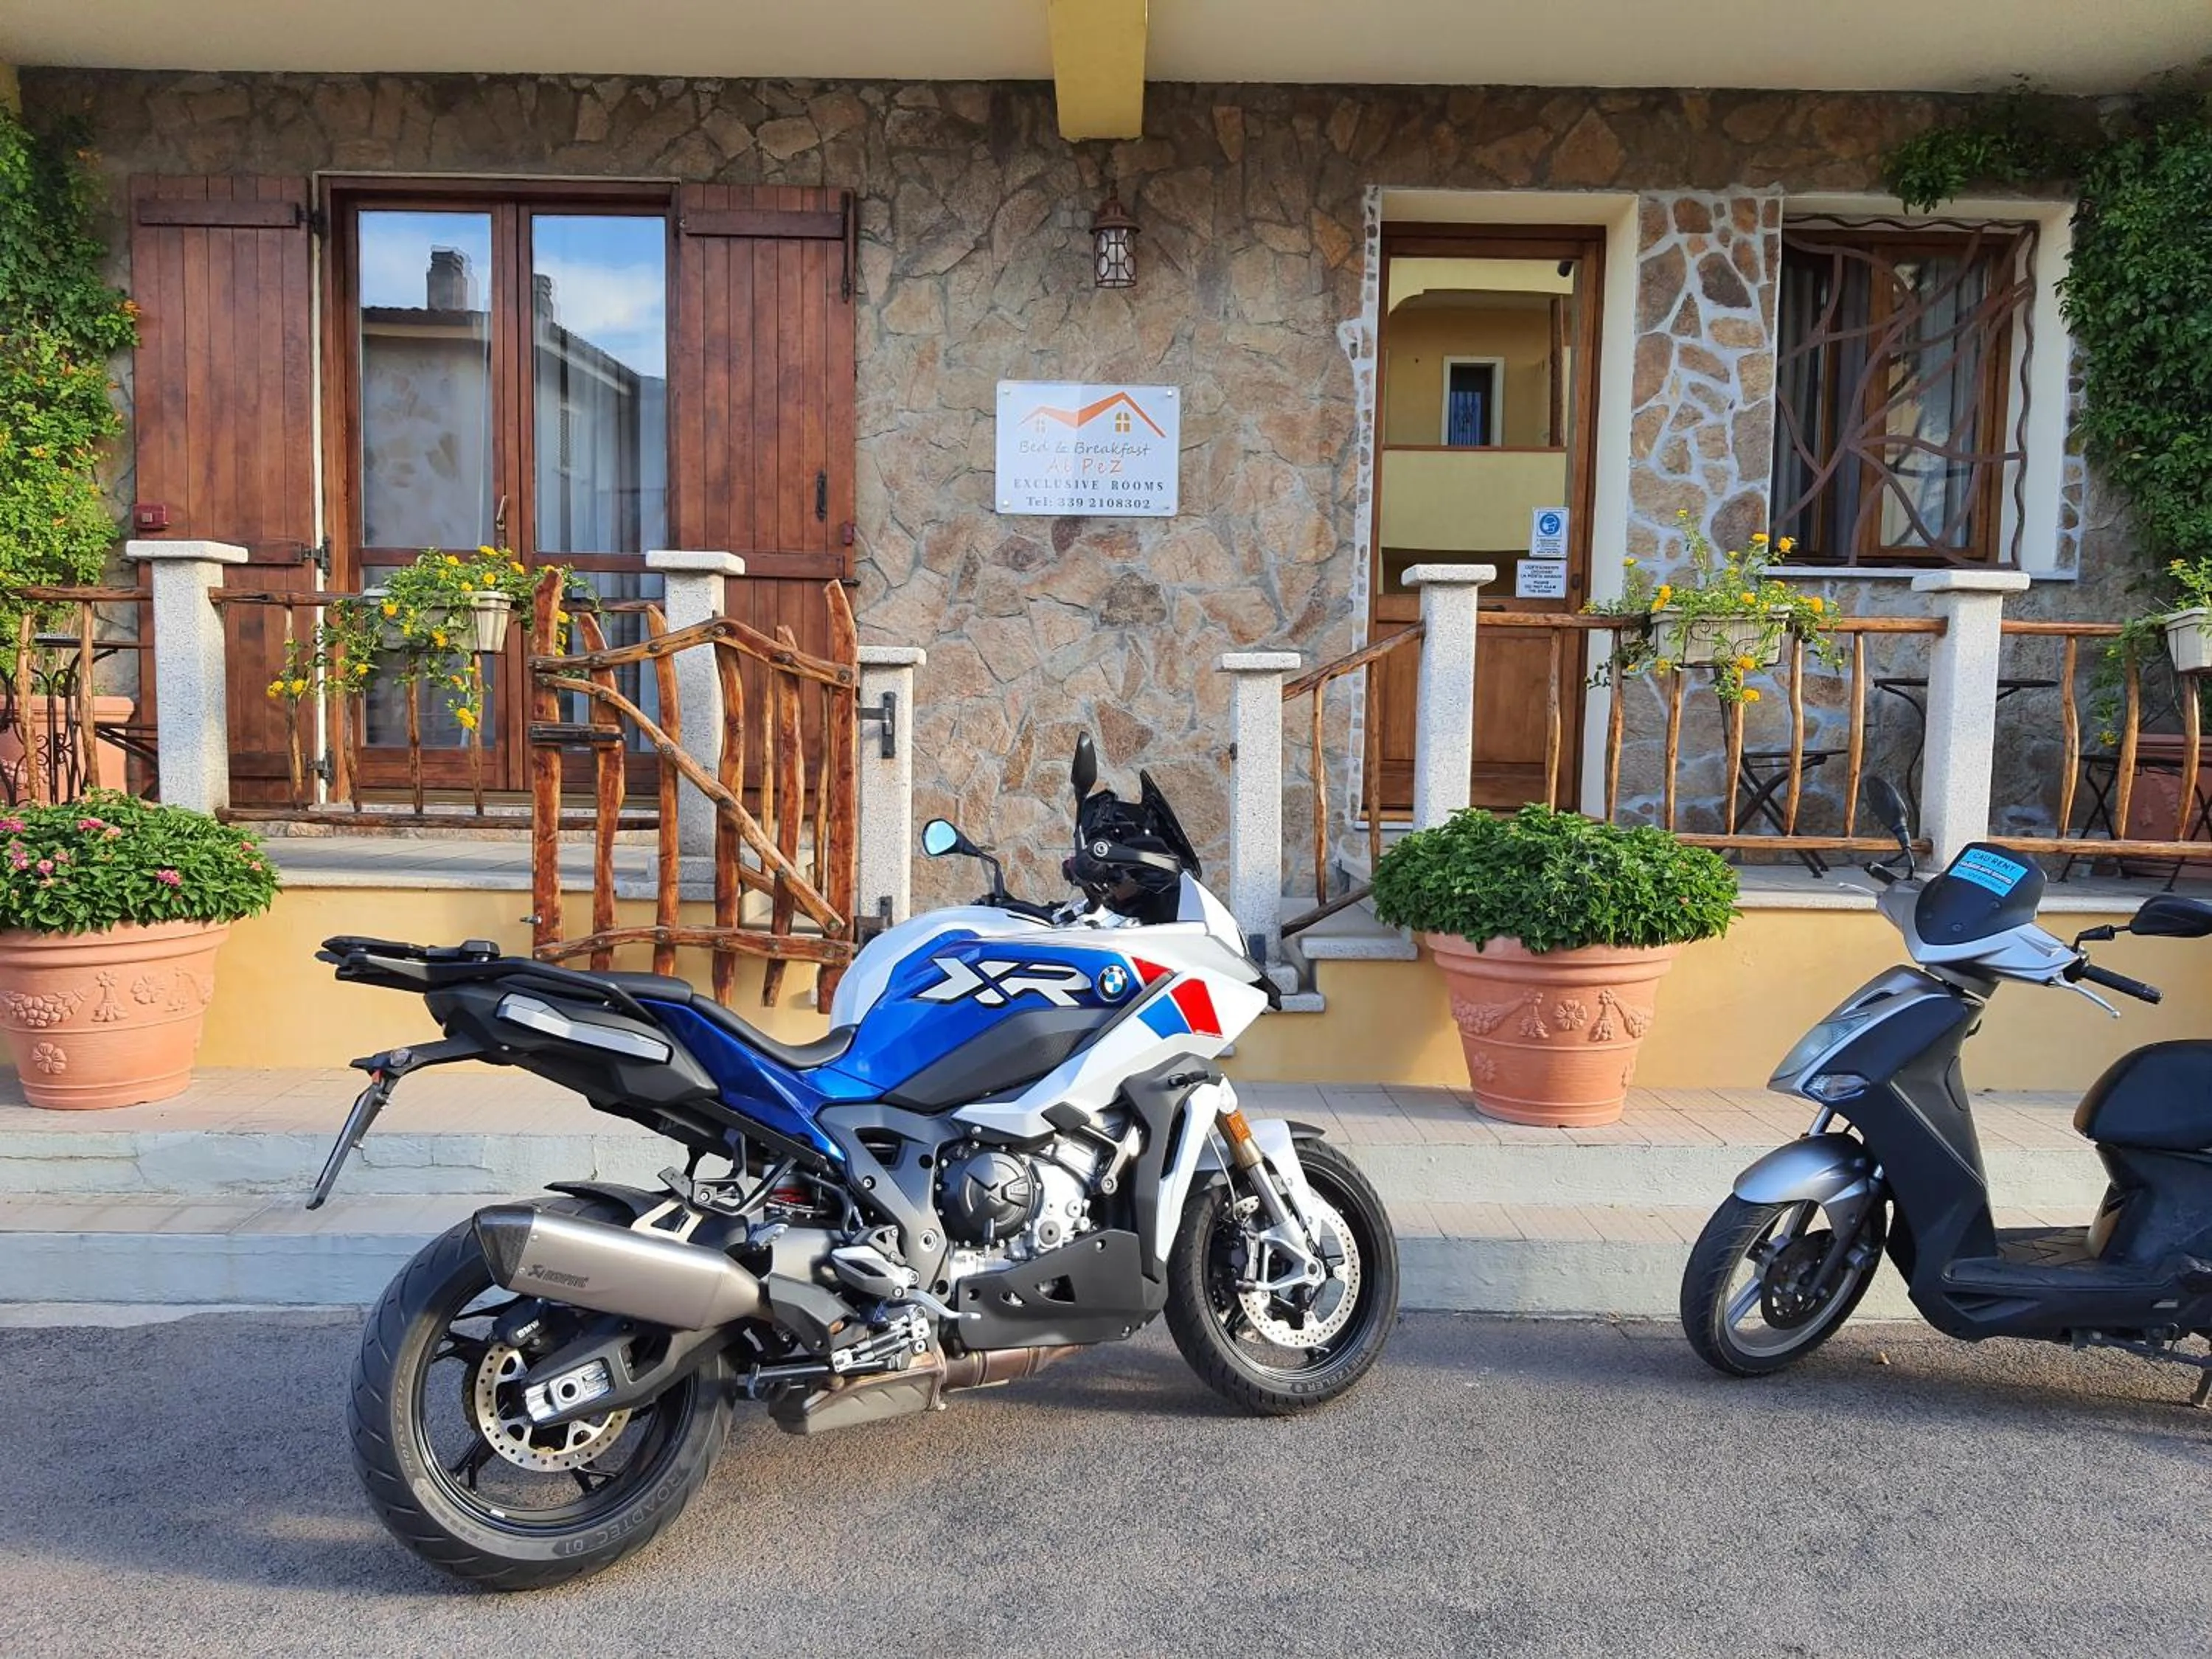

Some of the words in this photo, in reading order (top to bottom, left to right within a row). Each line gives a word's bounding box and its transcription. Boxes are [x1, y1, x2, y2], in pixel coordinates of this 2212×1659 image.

[1019, 440, 1048, 453] Bed
[1074, 442, 1151, 458] Breakfast
[1014, 479, 1099, 490] EXCLUSIVE
[1111, 480, 1164, 492] ROOMS
[1026, 496, 1053, 507] Tel:
[1057, 498, 1083, 508] 339
[1089, 498, 1150, 509] 2108302
[1992, 858, 2016, 872] RENT
[911, 957, 1091, 1008] XR
[596, 1471, 684, 1545] ROADTEC
[565, 1539, 584, 1554] 01
